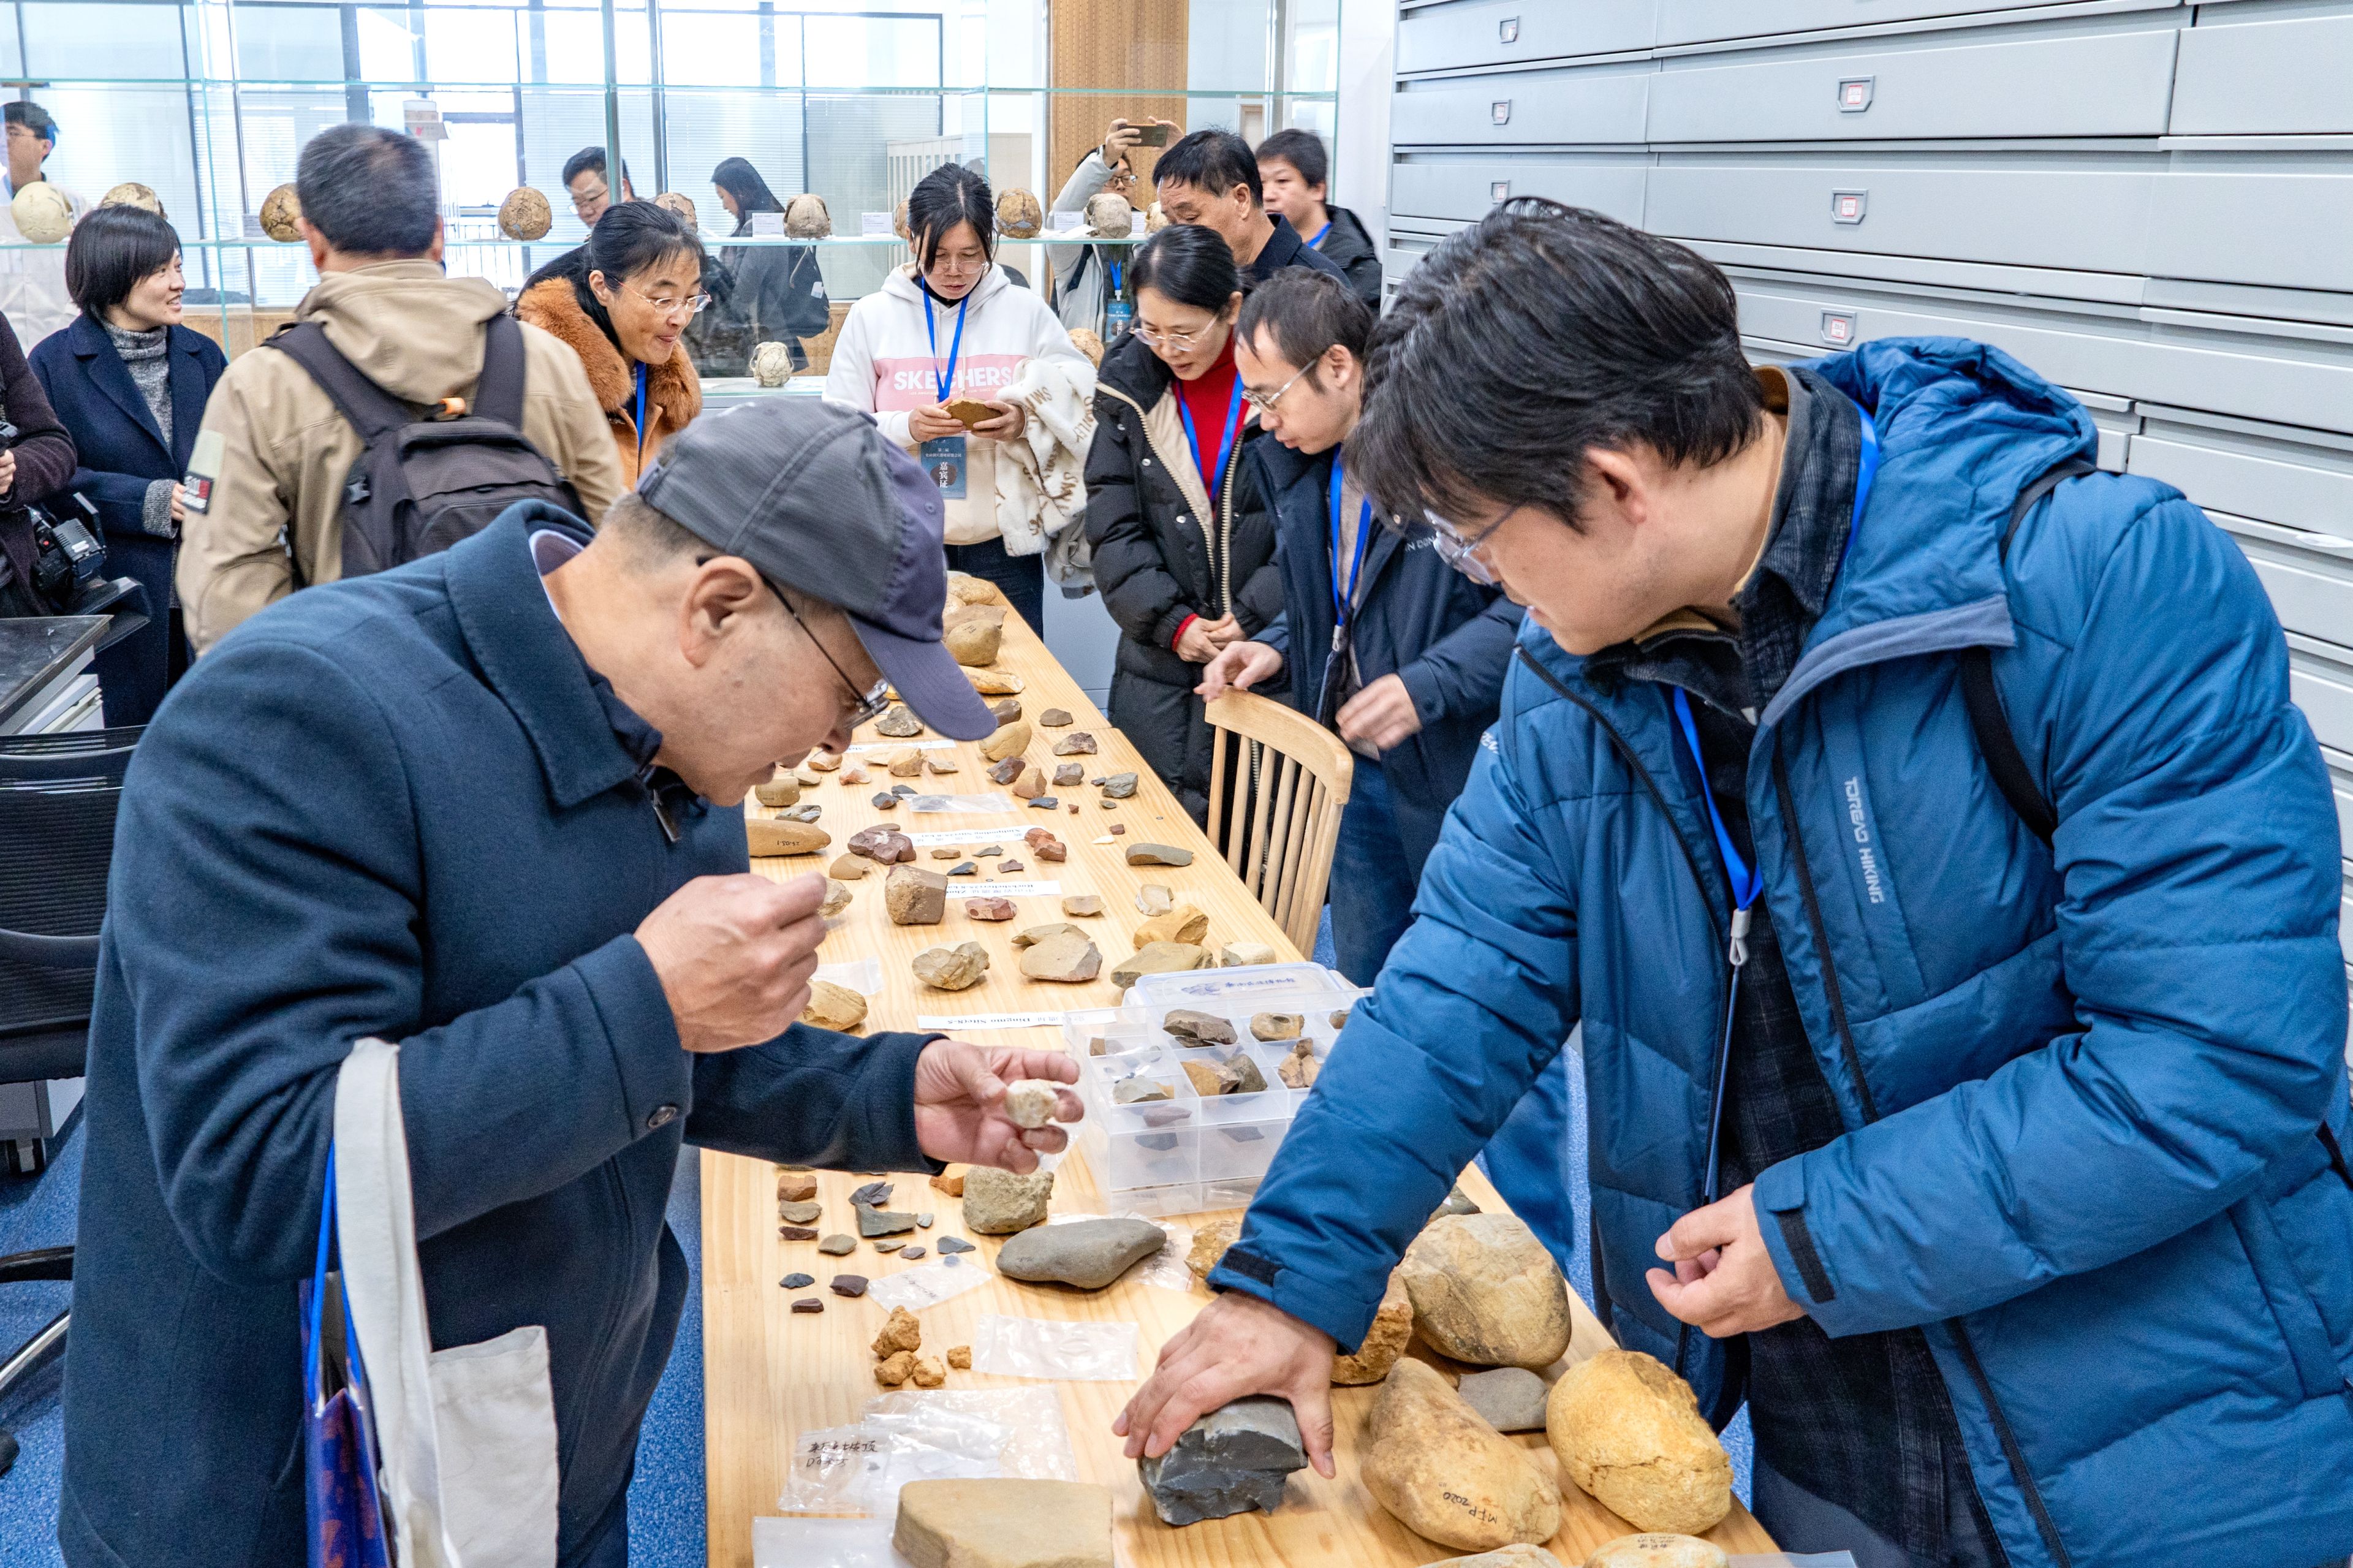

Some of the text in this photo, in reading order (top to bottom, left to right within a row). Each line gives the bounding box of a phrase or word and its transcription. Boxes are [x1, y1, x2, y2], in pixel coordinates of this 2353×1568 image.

[939, 461, 948, 488] 嘉宾证
[1844, 776, 1885, 904] TOREAD HIKING
